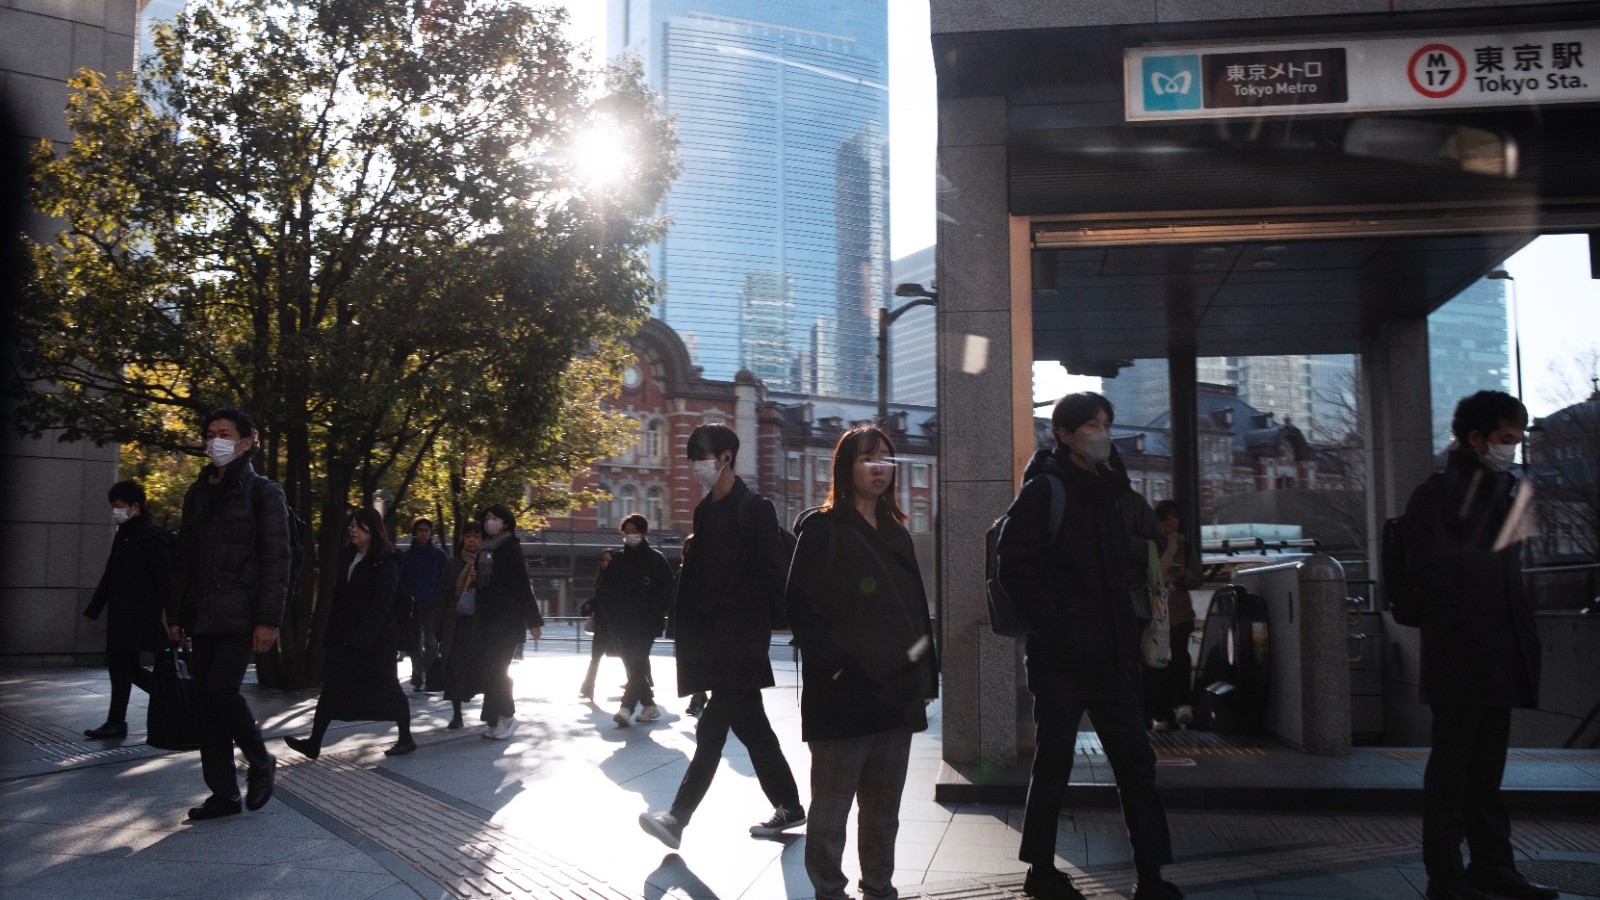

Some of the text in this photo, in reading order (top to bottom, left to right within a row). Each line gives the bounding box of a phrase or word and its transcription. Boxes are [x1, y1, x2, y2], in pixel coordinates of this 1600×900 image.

[1427, 53, 1447, 68] M
[1474, 42, 1584, 73] 東京駅
[1226, 61, 1322, 81] 東京メトロ
[1425, 70, 1451, 86] 17
[1233, 82, 1318, 97] Tokyo Metro
[1475, 72, 1588, 95] Tokyo Sta.
